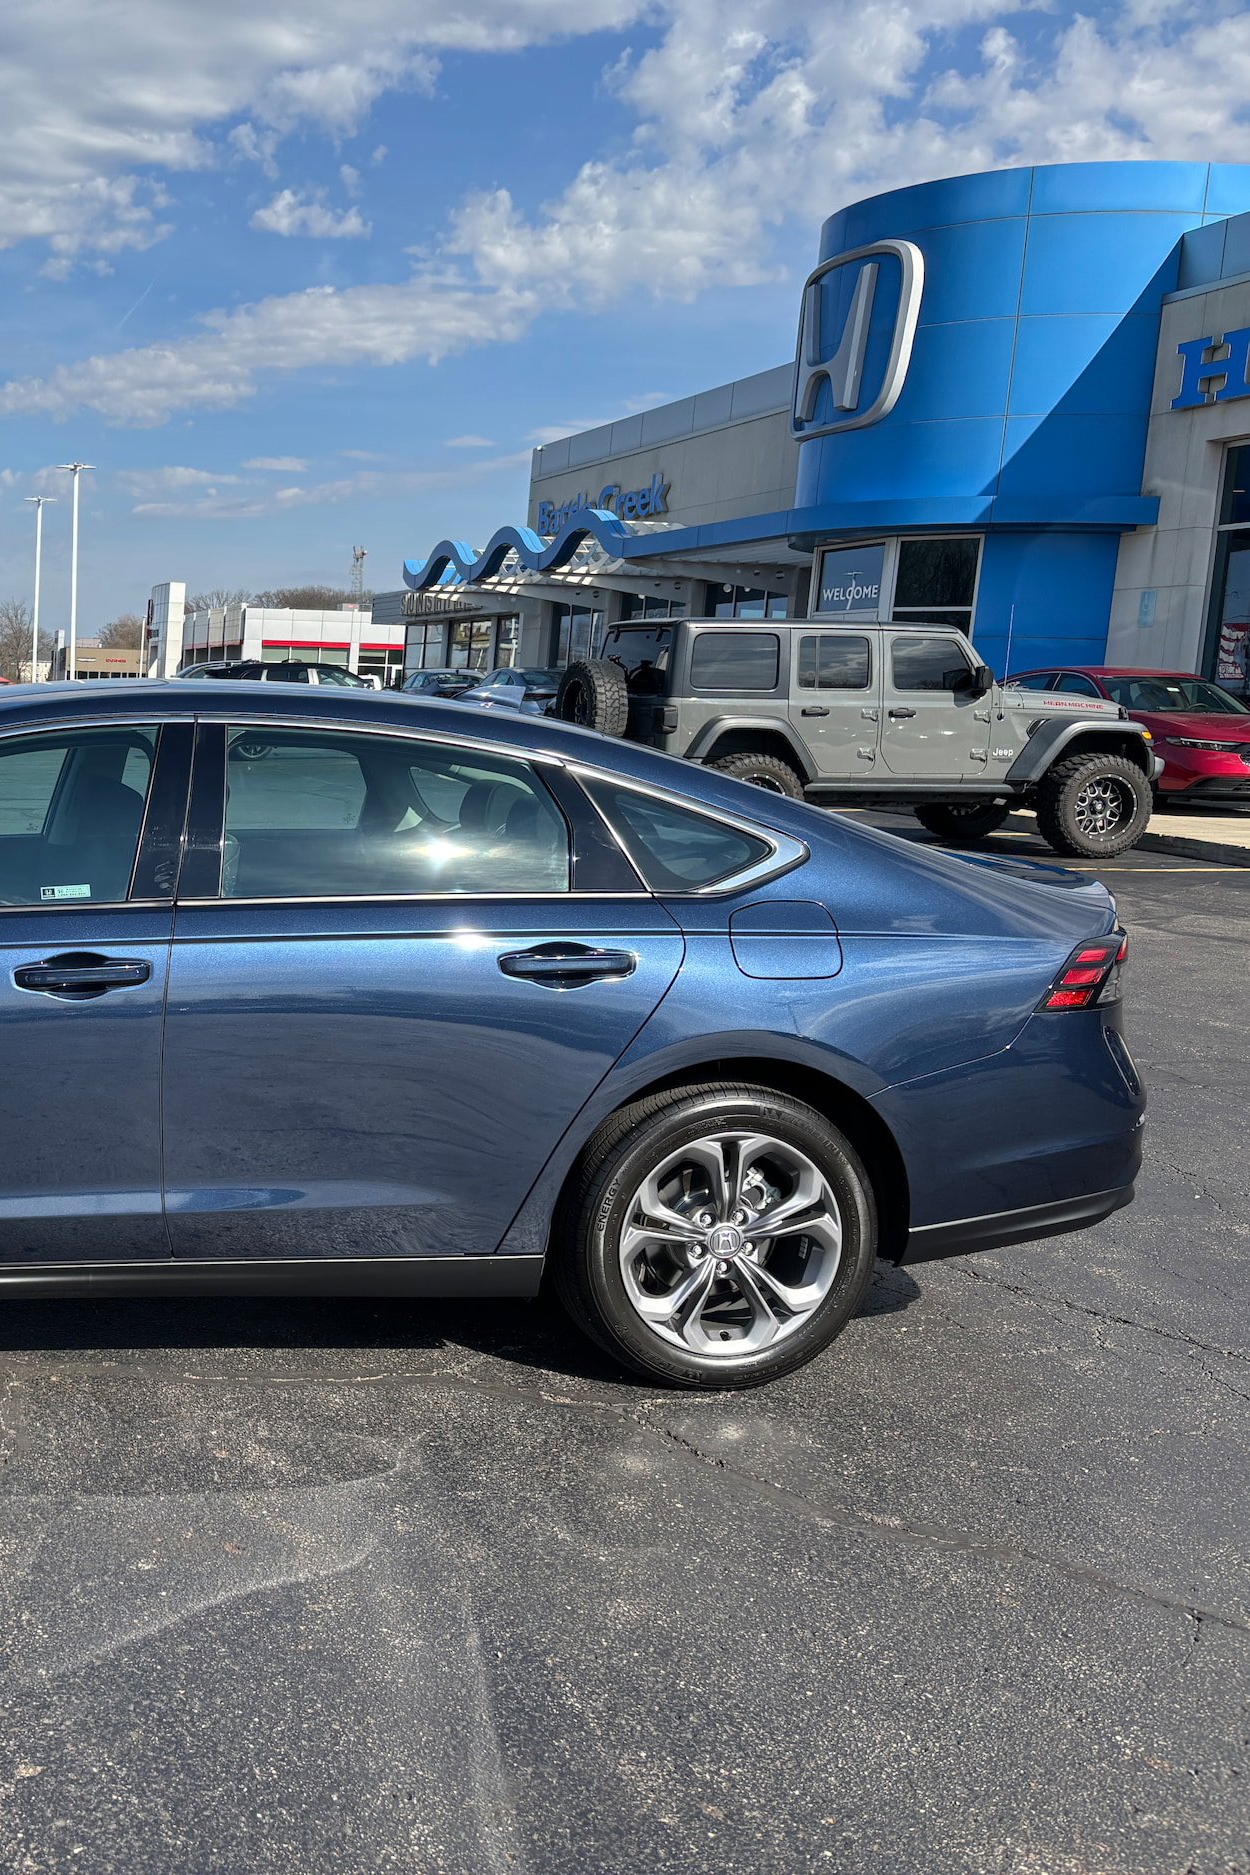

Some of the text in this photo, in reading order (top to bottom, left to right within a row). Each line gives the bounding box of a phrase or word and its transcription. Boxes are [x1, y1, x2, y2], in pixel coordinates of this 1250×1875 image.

[600, 473, 666, 522] Creek
[822, 584, 879, 601] WELCOME
[1068, 702, 1103, 710] MACHINE
[992, 747, 1014, 757] Jeep
[596, 1178, 622, 1232] ENERGY
